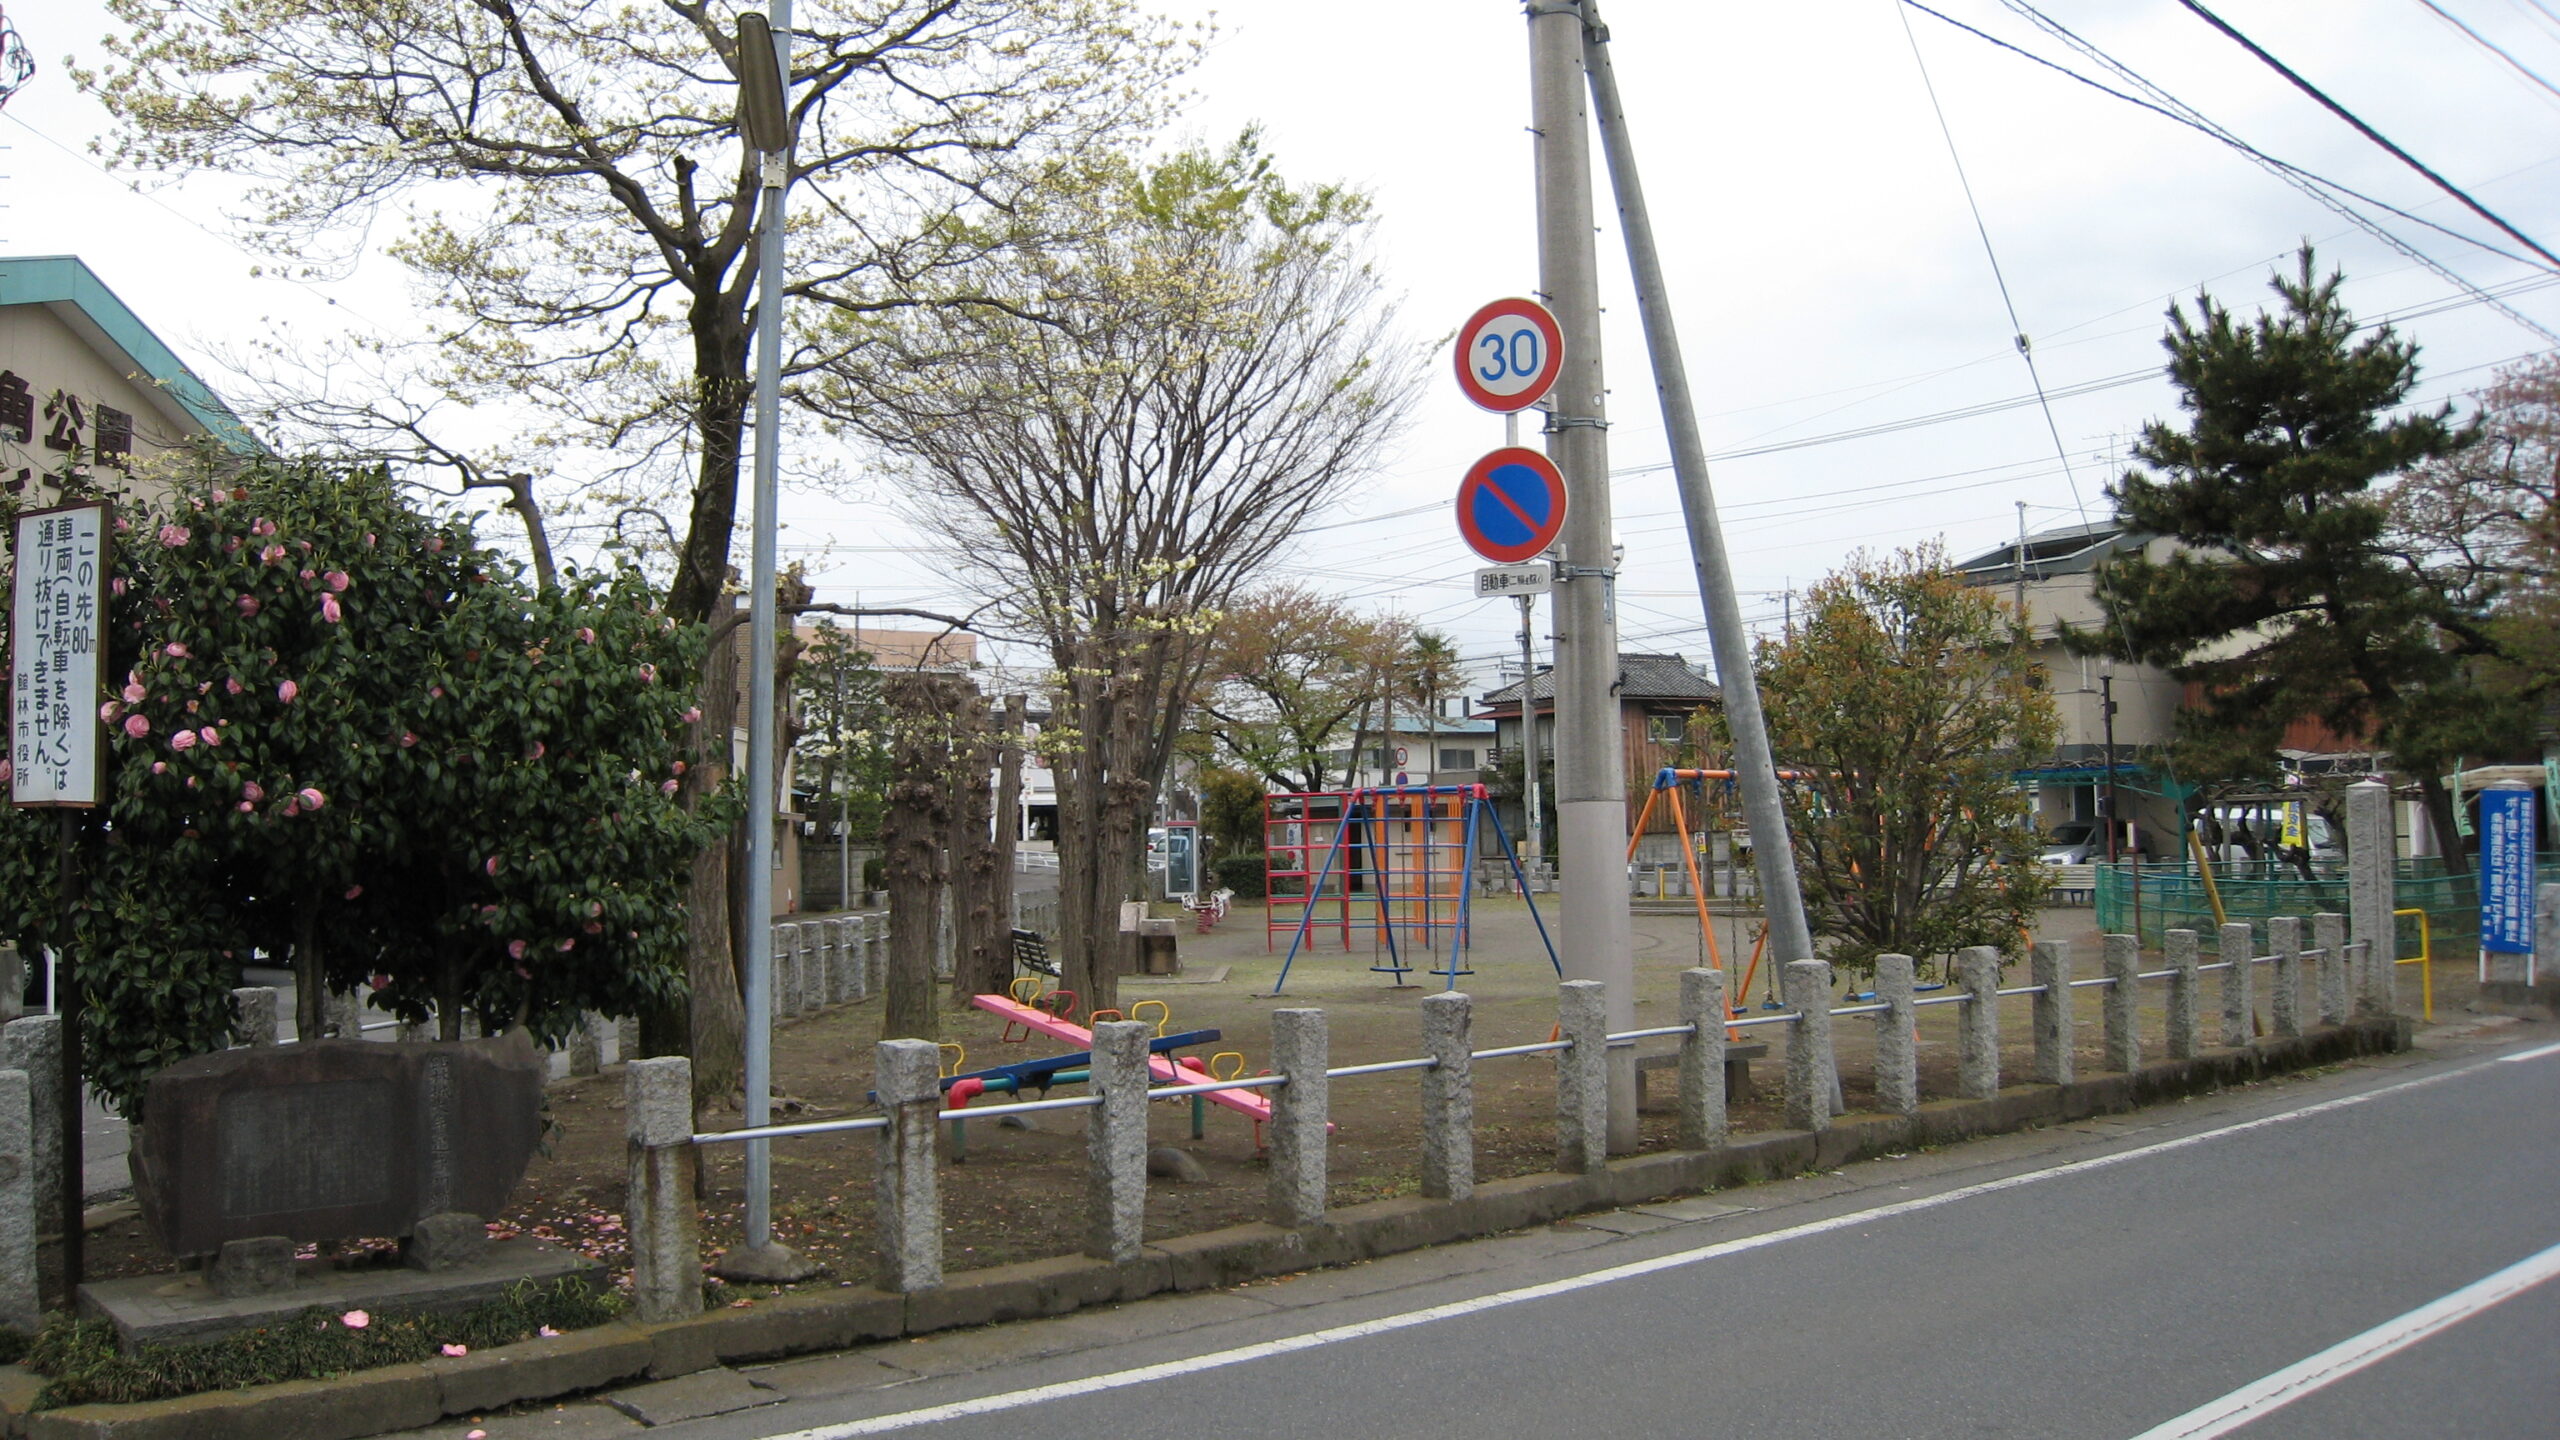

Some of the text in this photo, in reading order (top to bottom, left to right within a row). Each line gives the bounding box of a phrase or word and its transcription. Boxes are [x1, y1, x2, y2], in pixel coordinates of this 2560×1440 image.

[1479, 328, 1538, 381] 30
[34, 519, 54, 775] 通り抜けできません。
[53, 516, 74, 791] 車両（自転車を除く）は
[72, 531, 96, 654] この先80m
[17, 673, 29, 787] 館林市役所
